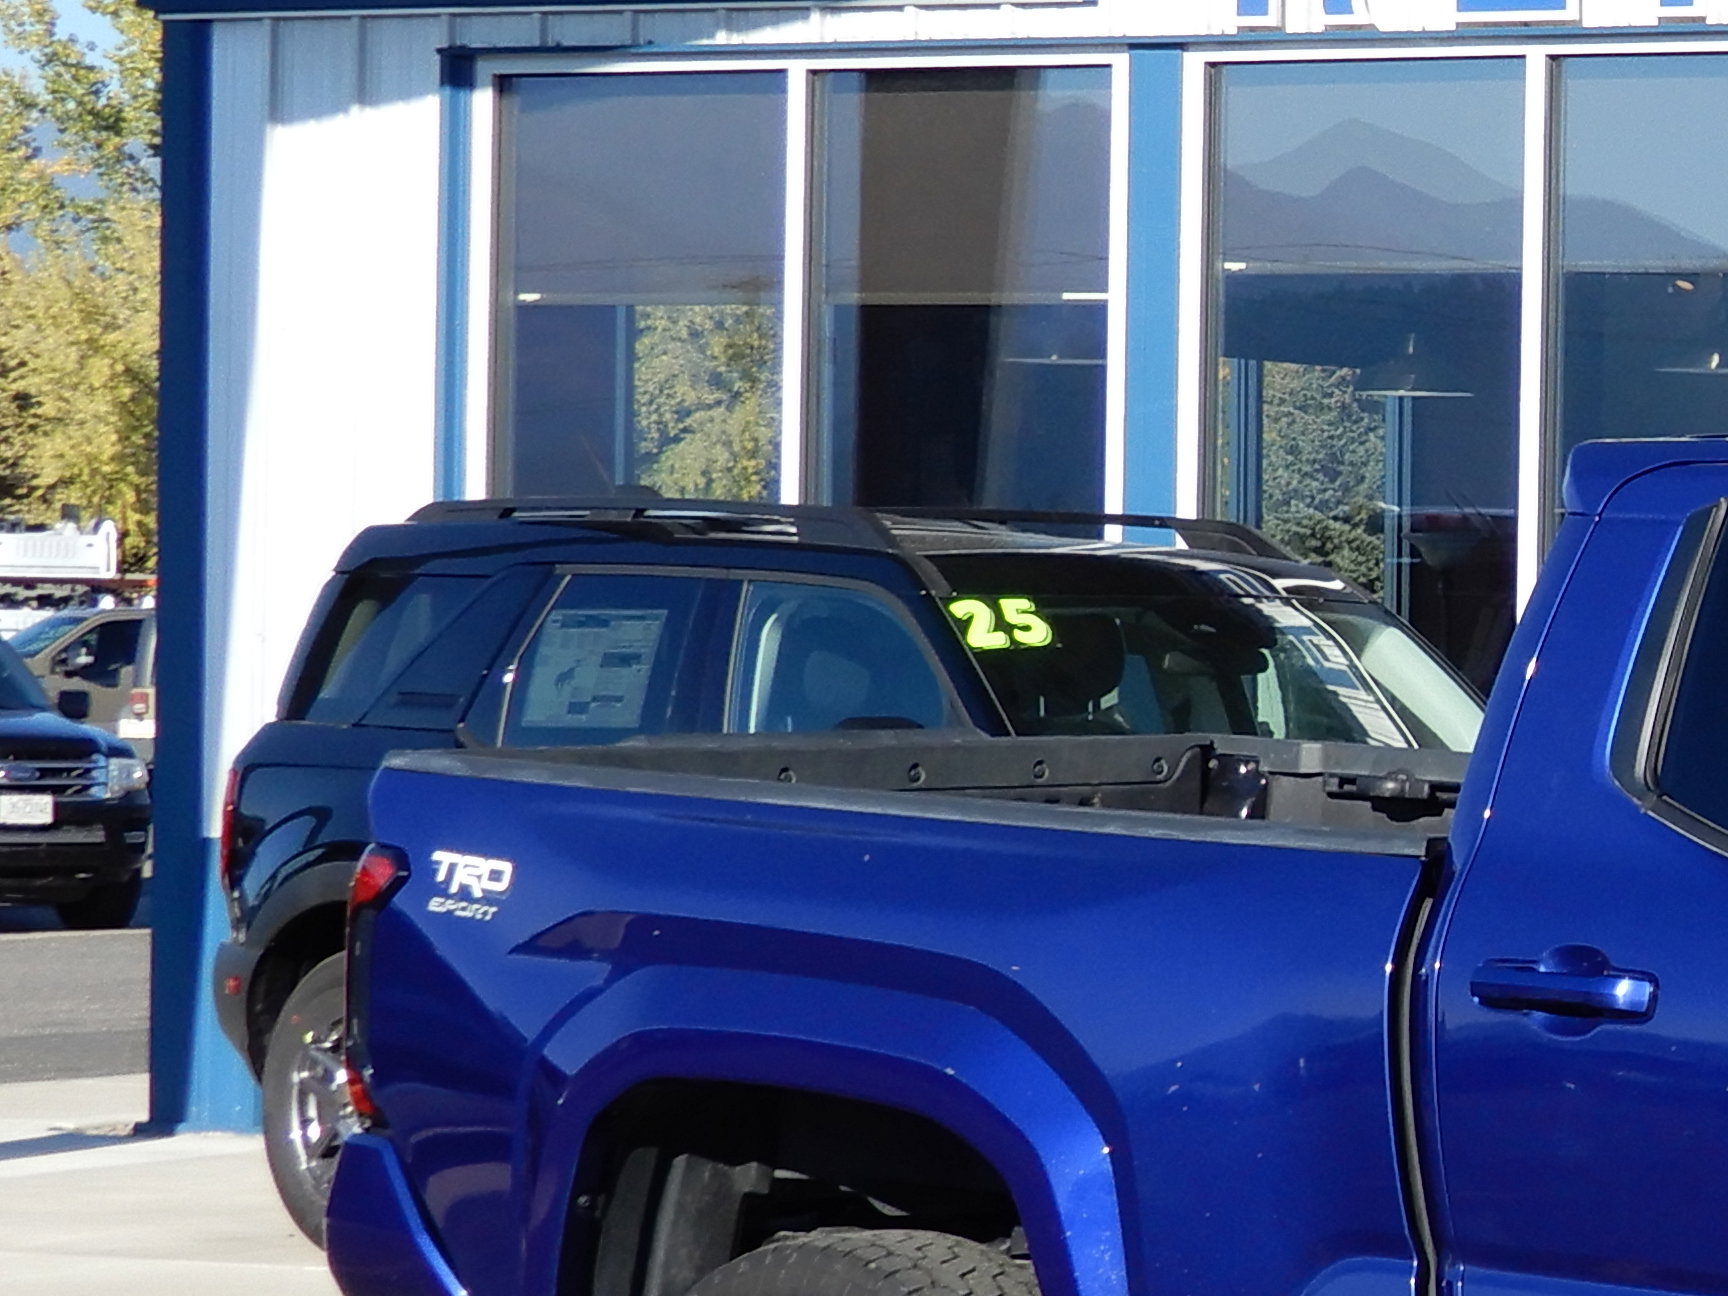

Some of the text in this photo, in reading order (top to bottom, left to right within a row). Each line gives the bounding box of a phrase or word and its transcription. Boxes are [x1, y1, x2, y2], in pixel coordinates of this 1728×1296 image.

[948, 597, 1053, 650] 25
[431, 850, 513, 898] TRD
[427, 896, 498, 921] SPORT
